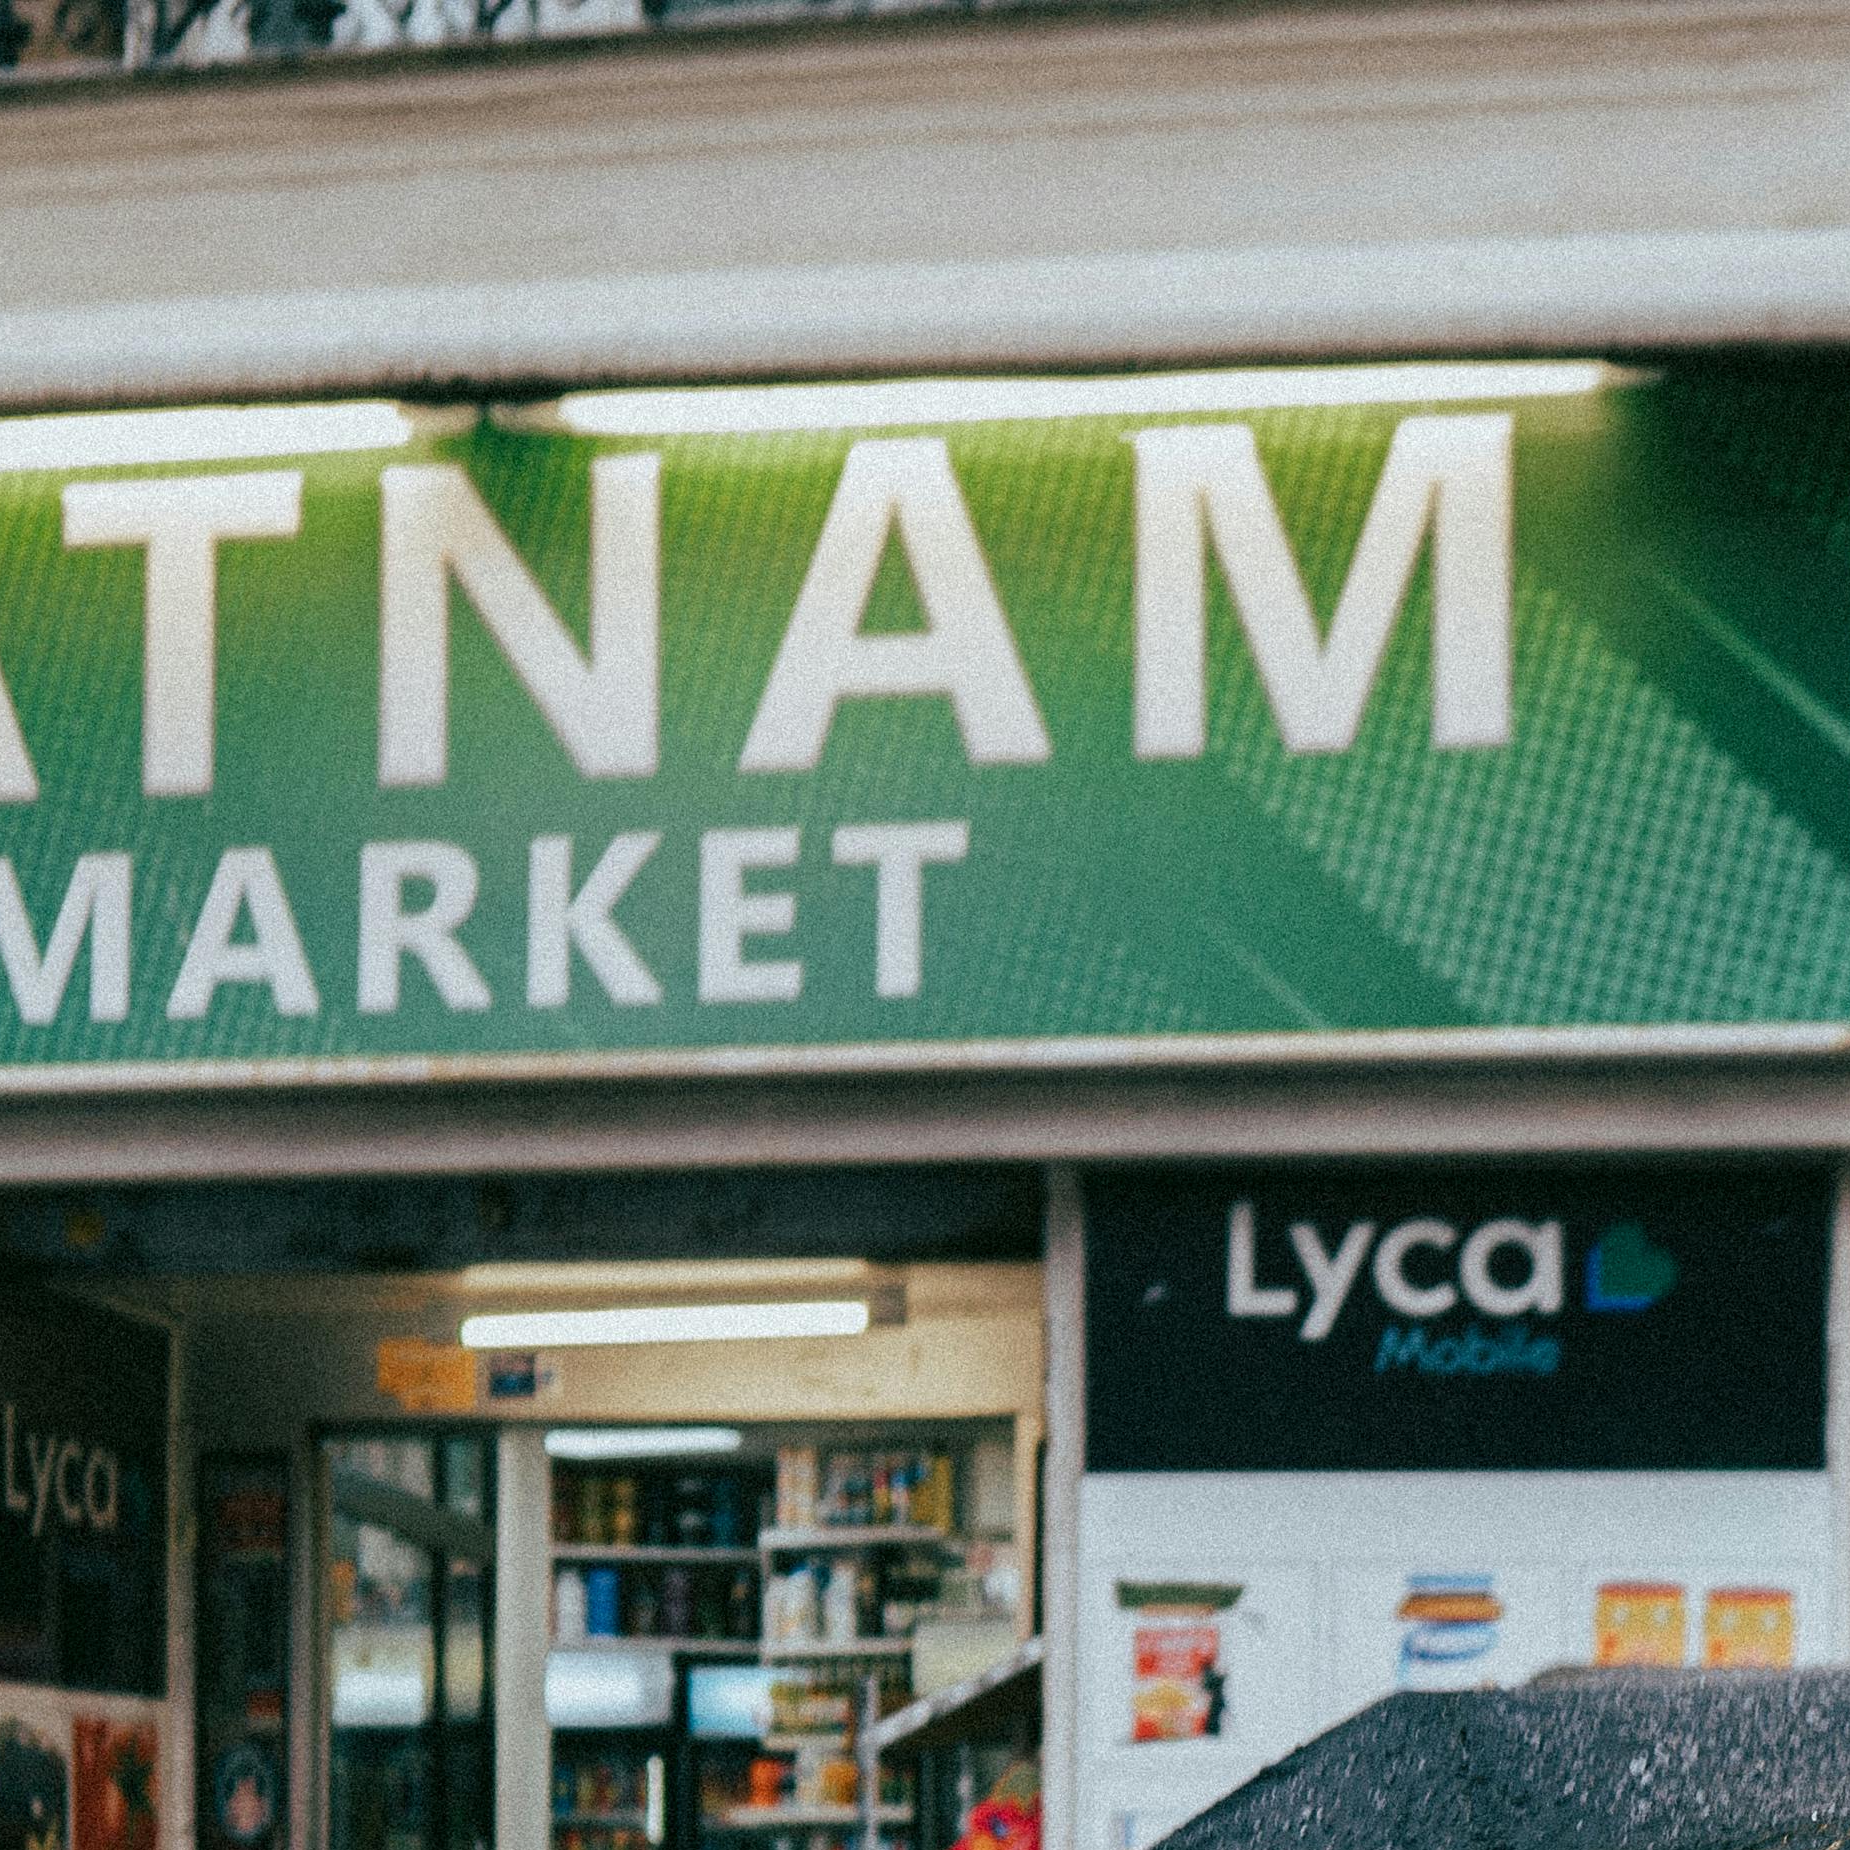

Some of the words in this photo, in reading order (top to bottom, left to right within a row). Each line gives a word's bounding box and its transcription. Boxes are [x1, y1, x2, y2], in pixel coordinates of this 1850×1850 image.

[1225, 1202, 1564, 1341] Lyca
[1373, 1325, 1562, 1374] Mobile
[4, 1403, 119, 1537] Lyca
